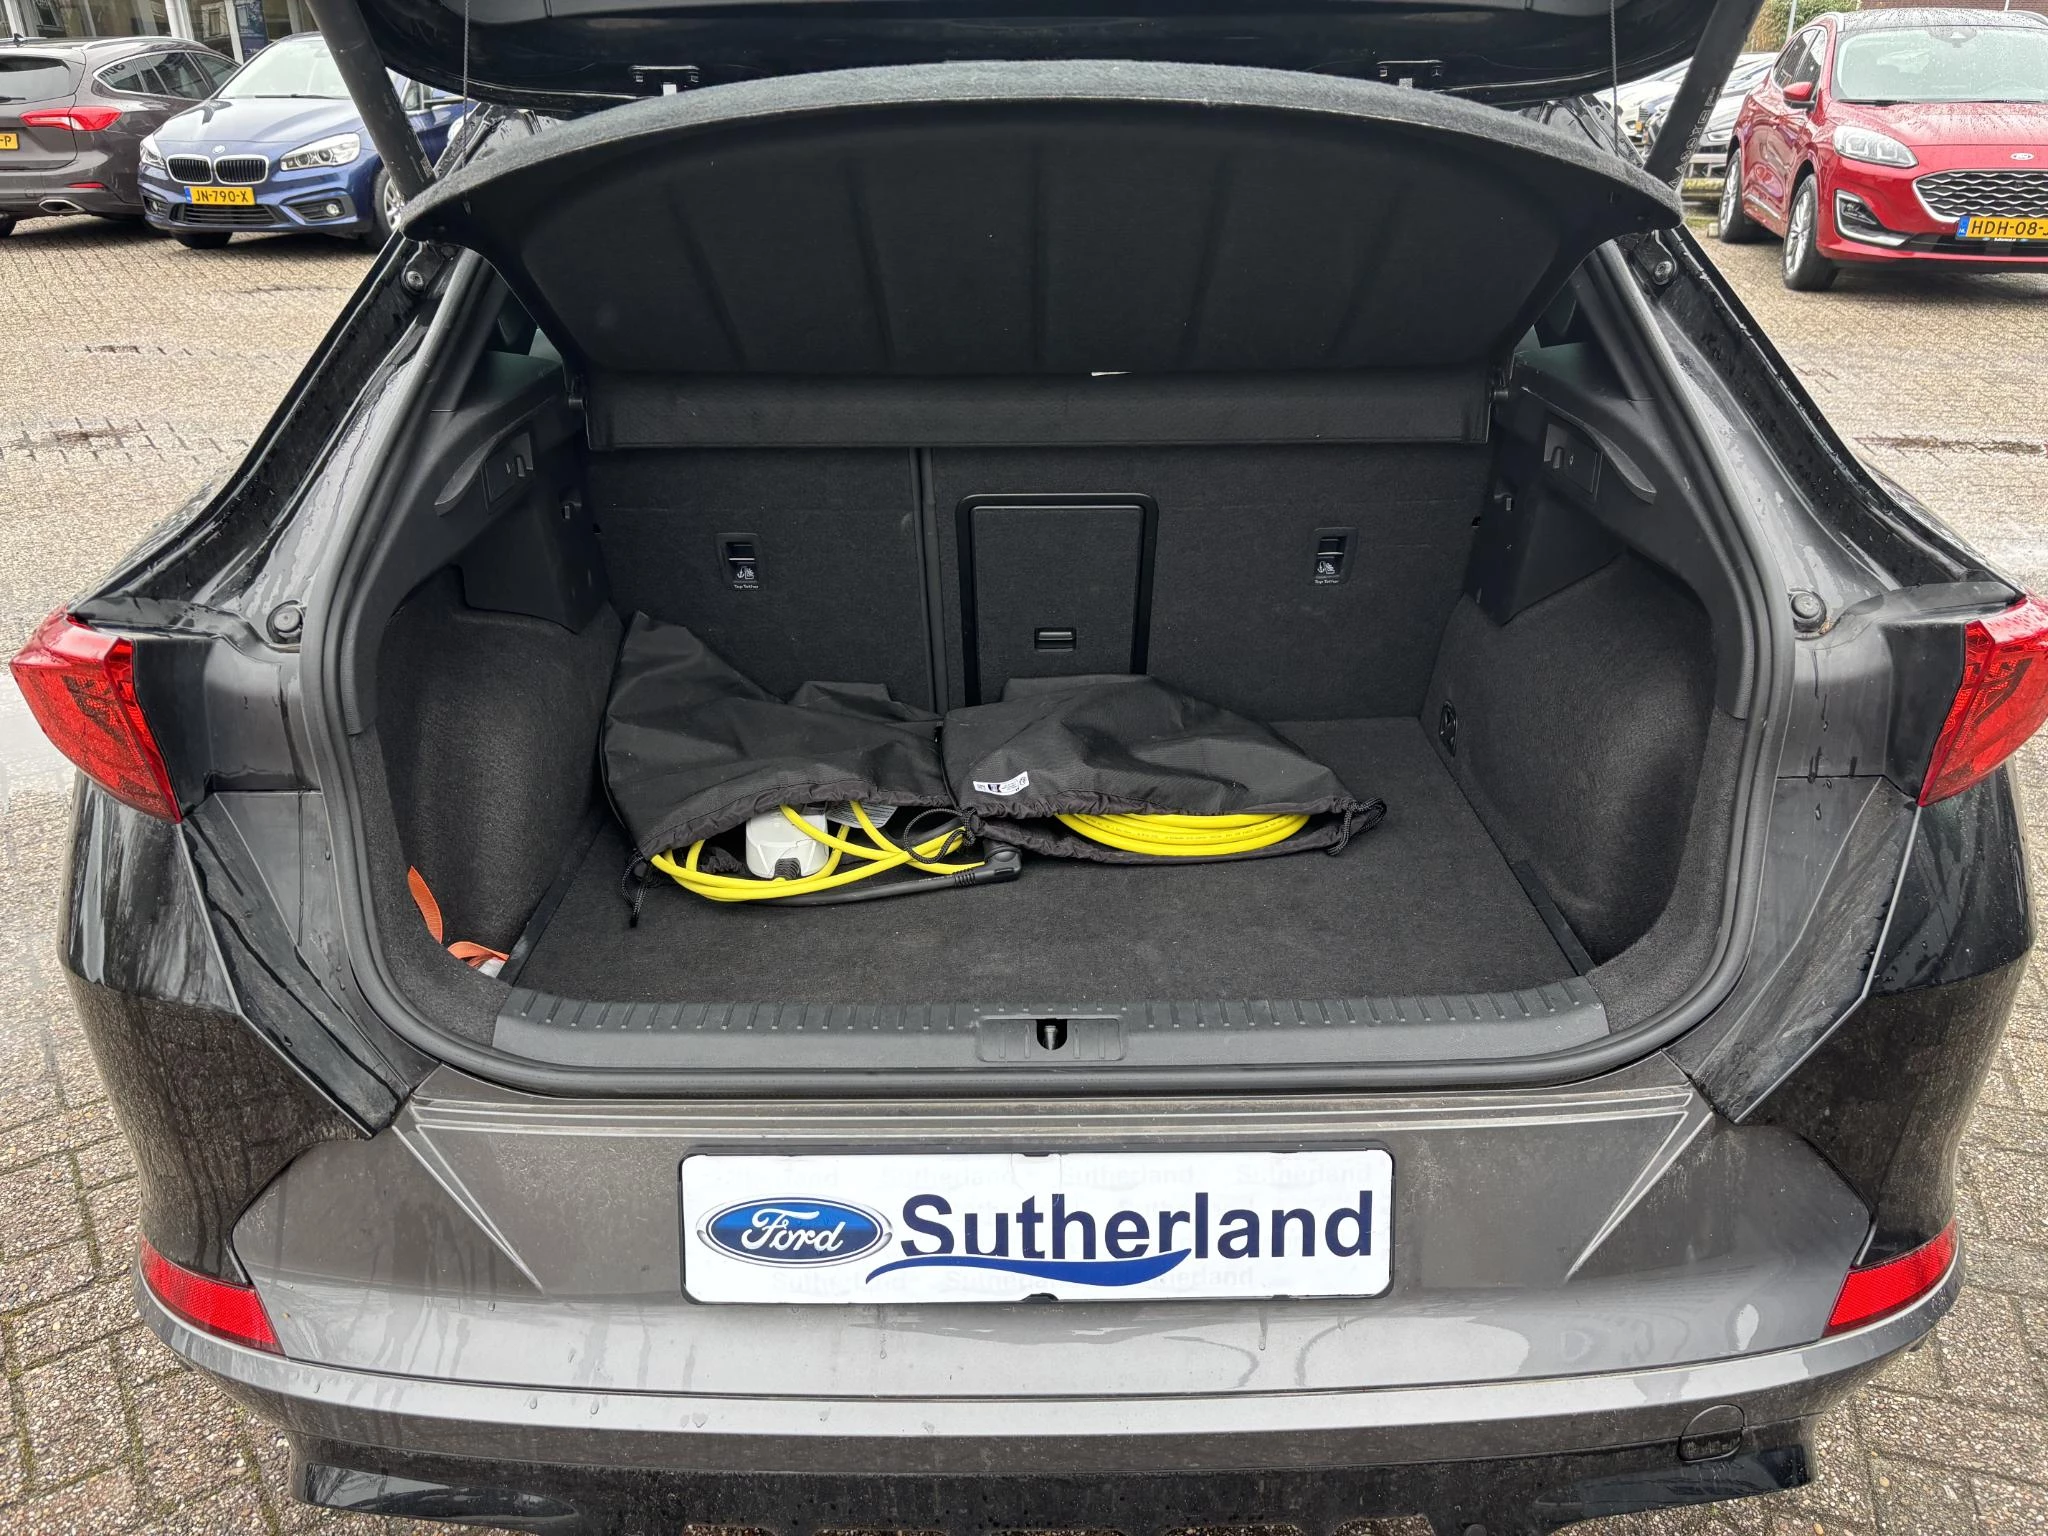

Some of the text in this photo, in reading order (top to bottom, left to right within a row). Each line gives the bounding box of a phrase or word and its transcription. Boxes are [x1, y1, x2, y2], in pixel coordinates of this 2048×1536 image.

[195, 190, 249, 203] JN-790-X
[741, 1208, 846, 1252] Ford
[900, 1190, 1373, 1260] Sutherland
